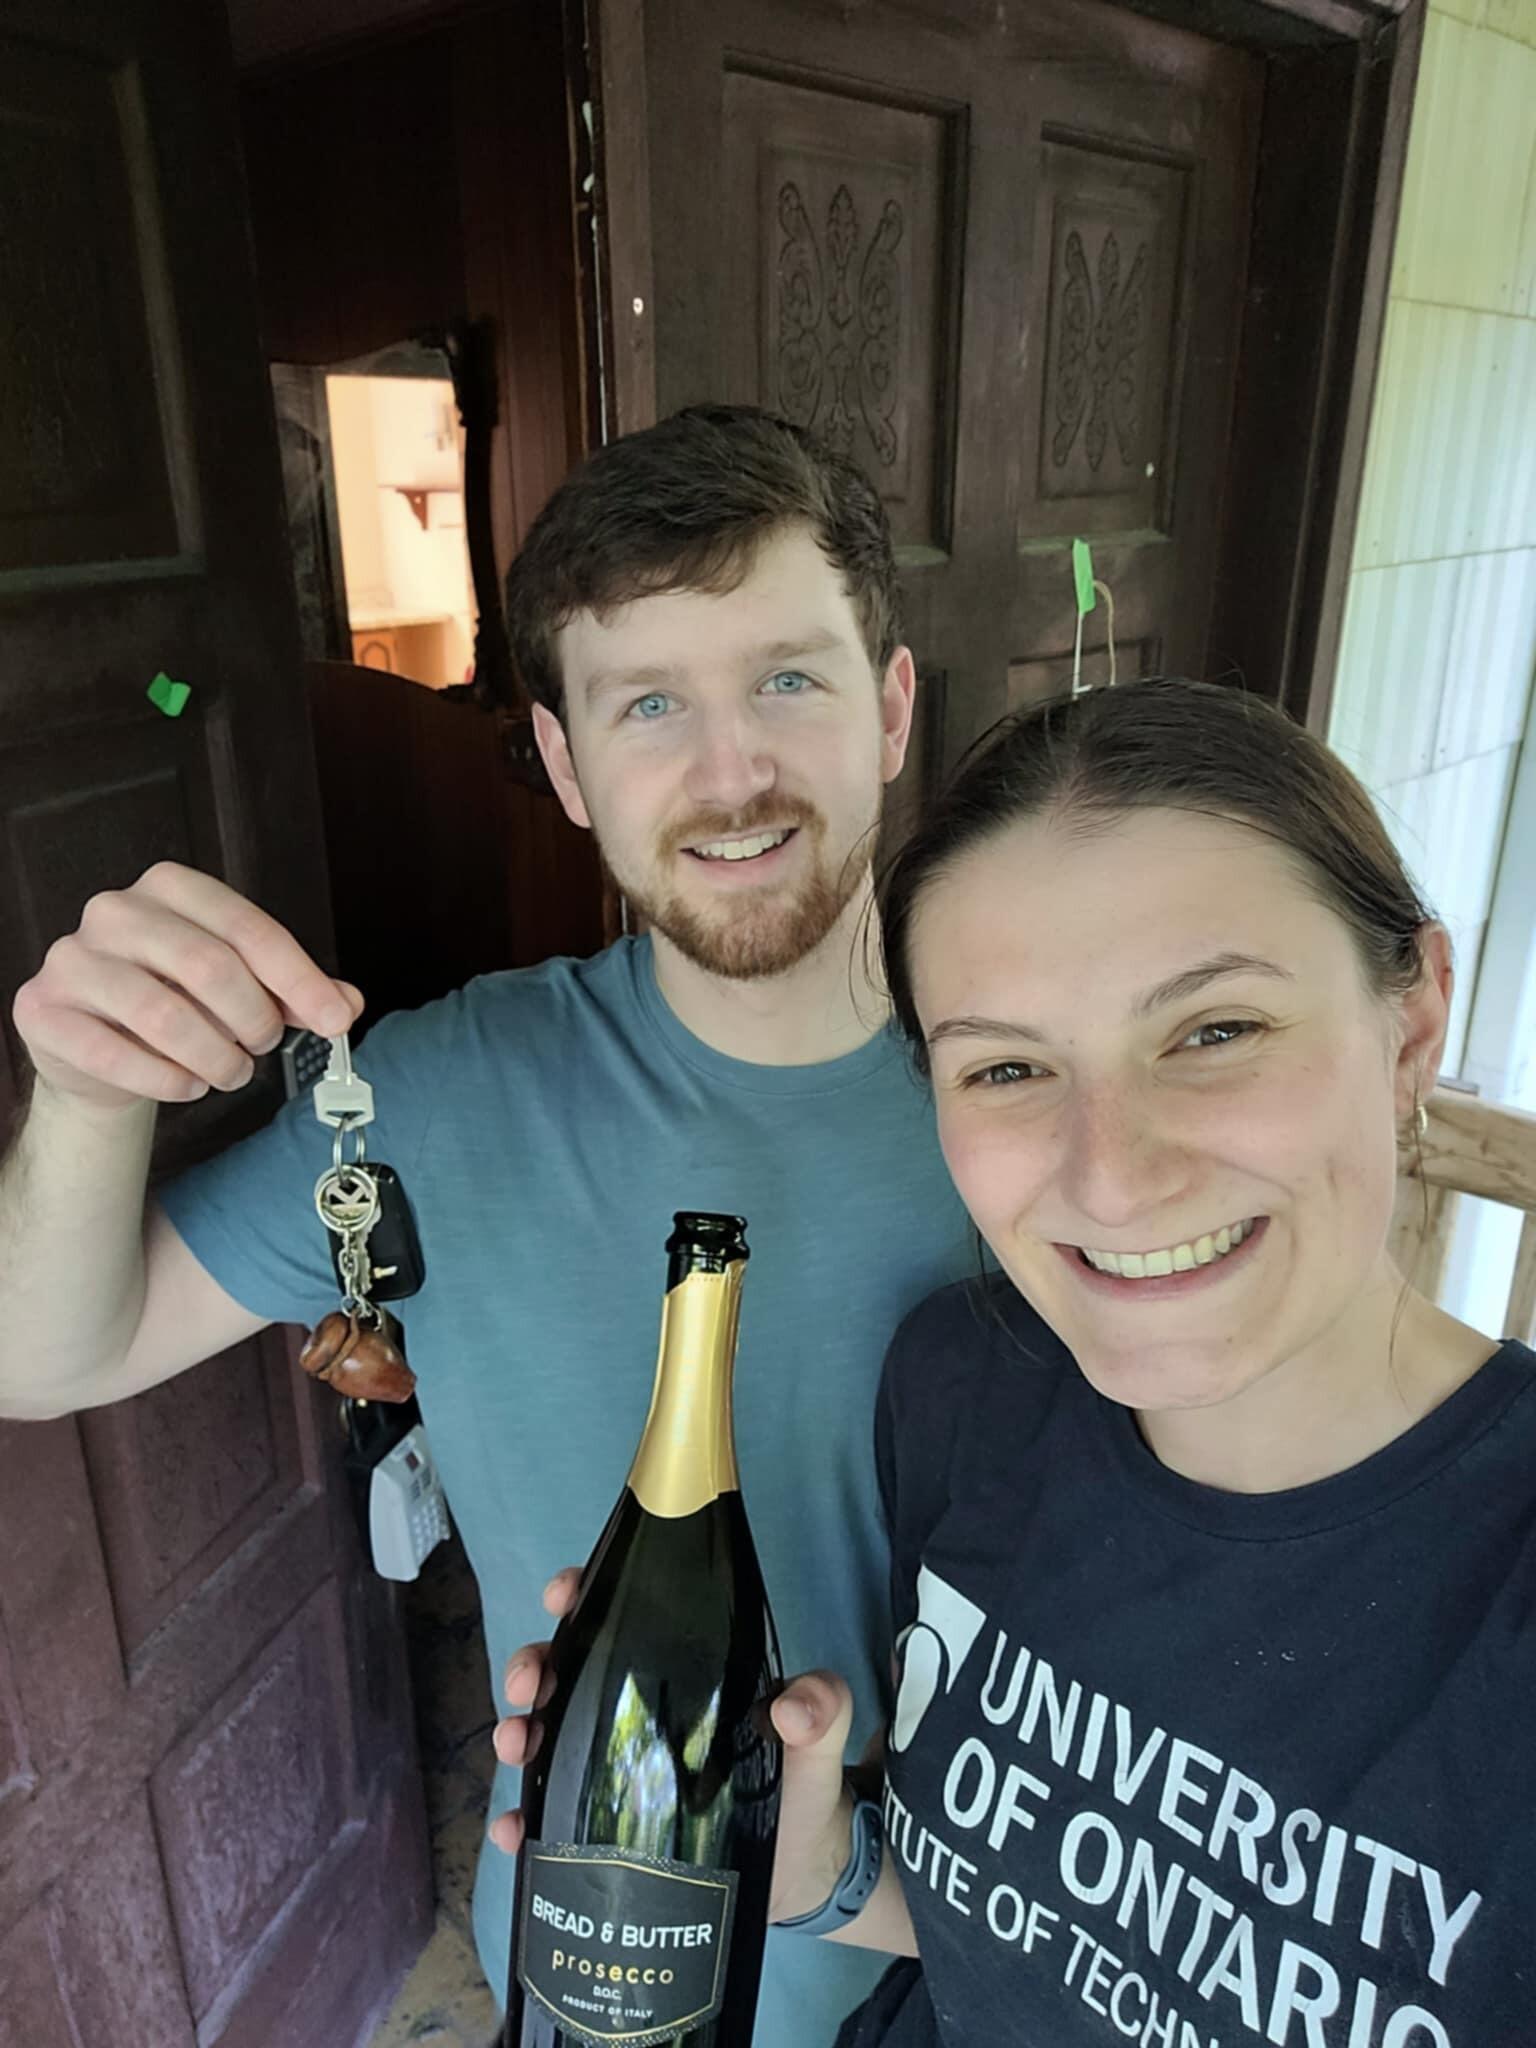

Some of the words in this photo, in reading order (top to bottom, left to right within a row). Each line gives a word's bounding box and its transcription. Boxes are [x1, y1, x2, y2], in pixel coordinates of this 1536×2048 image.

[943, 1737, 1051, 1851] OF
[980, 1629, 1482, 1987] UNIVERSITY
[532, 1894, 595, 1938] BREAD
[600, 1921, 615, 1944] &
[621, 1923, 713, 1948] BUTTER
[986, 1884, 1060, 1954] OF
[552, 1949, 674, 1985] prosecco
[562, 1993, 606, 2013] PRODUCT
[607, 2006, 622, 2016] OF
[624, 2008, 654, 2019] ITALY
